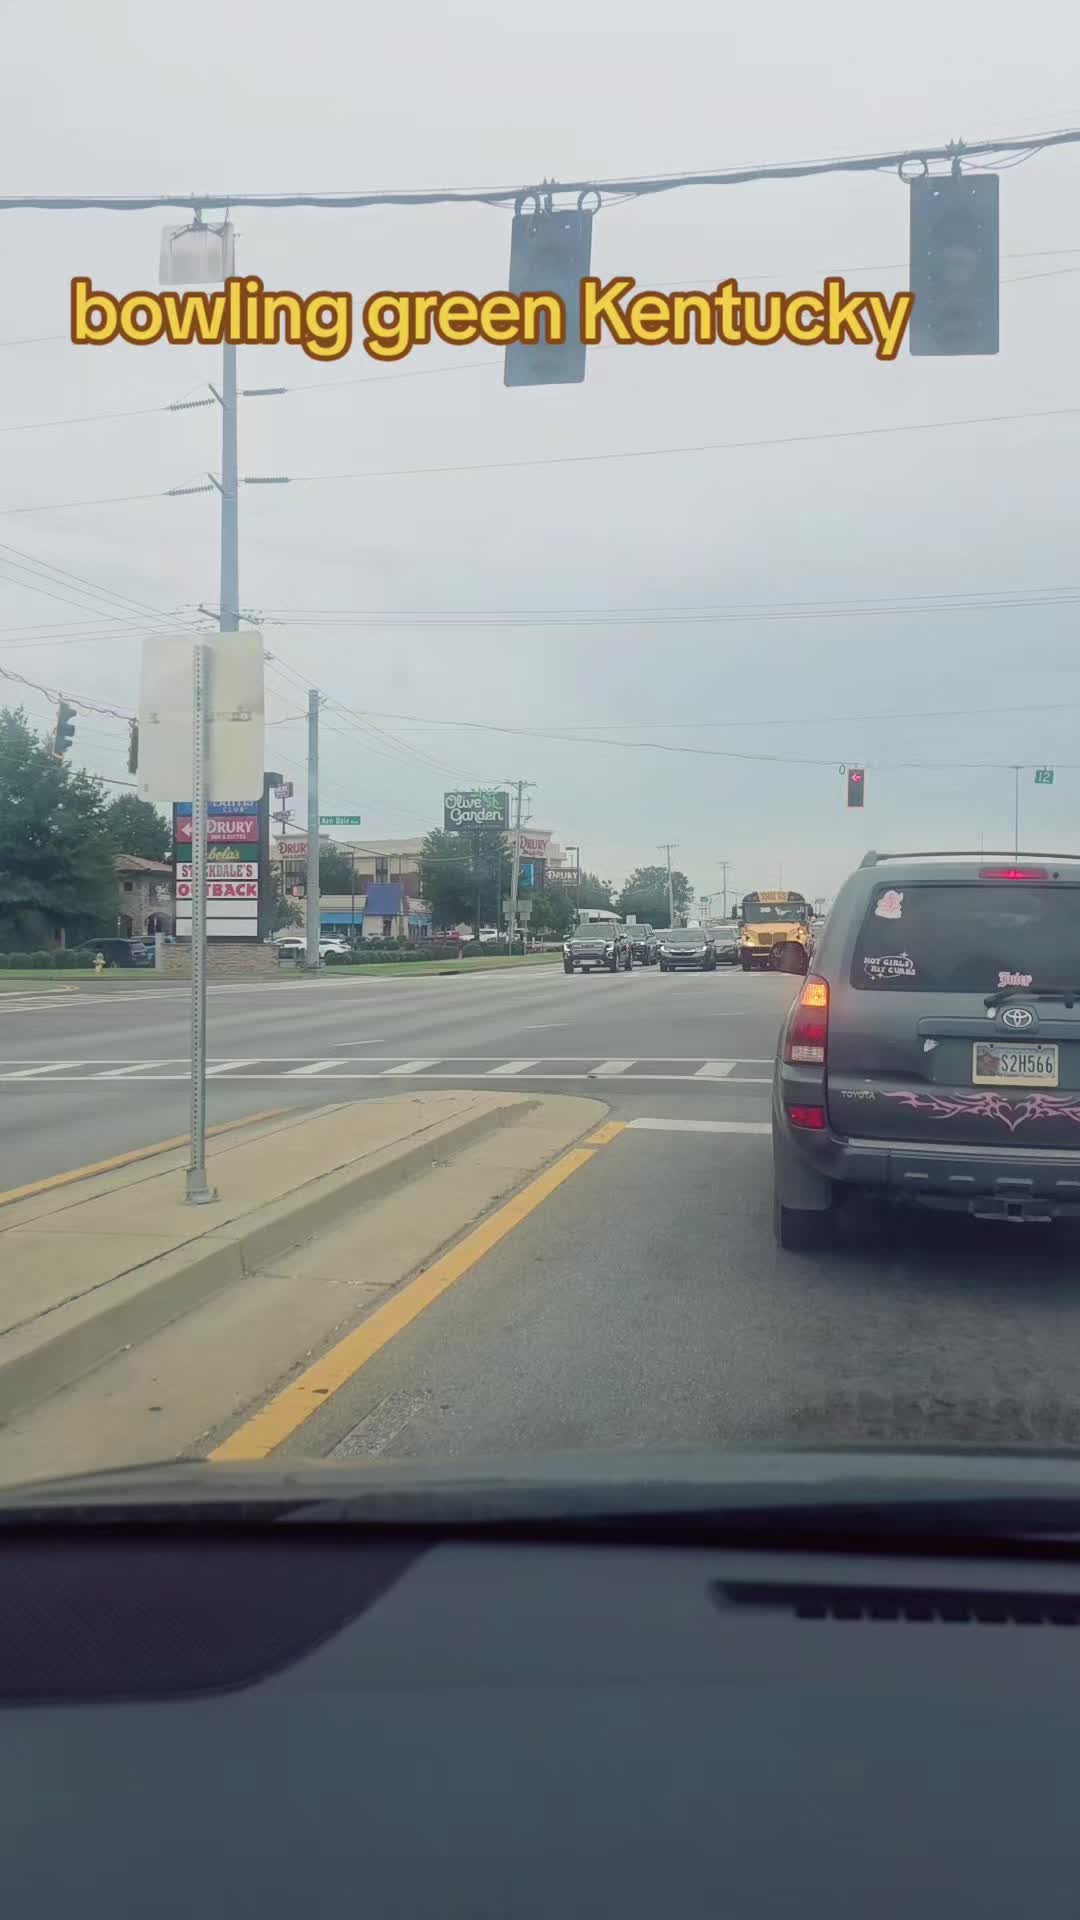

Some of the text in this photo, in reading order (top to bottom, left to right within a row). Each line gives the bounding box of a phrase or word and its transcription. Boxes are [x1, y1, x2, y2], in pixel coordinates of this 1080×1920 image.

[1038, 771, 1050, 783] 12
[445, 794, 482, 809] Olive
[450, 808, 504, 825] Garden
[206, 819, 253, 834] DRURY
[278, 842, 306, 854] DRUR
[520, 835, 547, 850] DRURY
[182, 864, 253, 878] STKDALE'S
[546, 870, 578, 880] DRURY
[883, 959, 910, 967] GIRLS
[888, 966, 916, 975] CURBS
[997, 971, 1033, 988] Juicy
[1001, 1054, 1053, 1073] S2H566
[840, 1090, 876, 1100] TOYOTA
